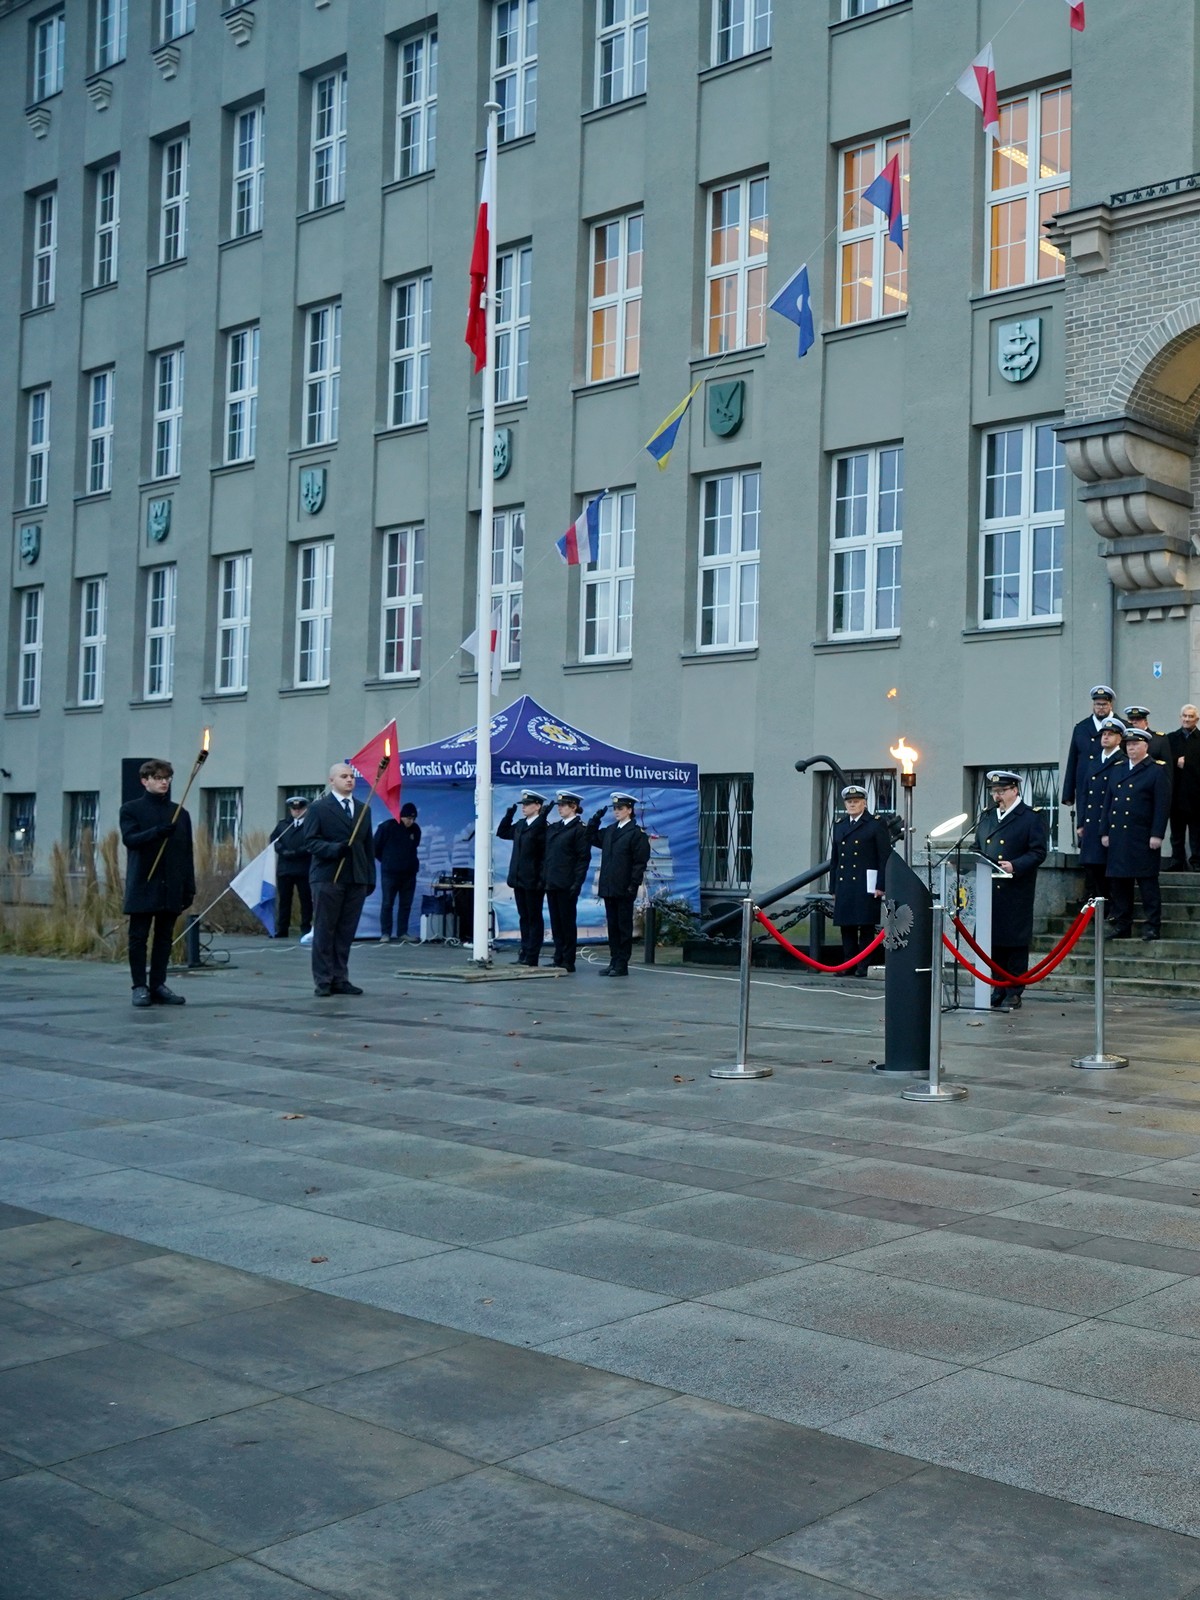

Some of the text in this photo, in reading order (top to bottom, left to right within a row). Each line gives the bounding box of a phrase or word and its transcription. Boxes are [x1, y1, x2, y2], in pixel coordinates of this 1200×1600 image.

[406, 762, 441, 777] Morski
[443, 765, 453, 776] w
[454, 760, 477, 778] Gdy
[500, 760, 691, 784] Gdynia Maritime University
